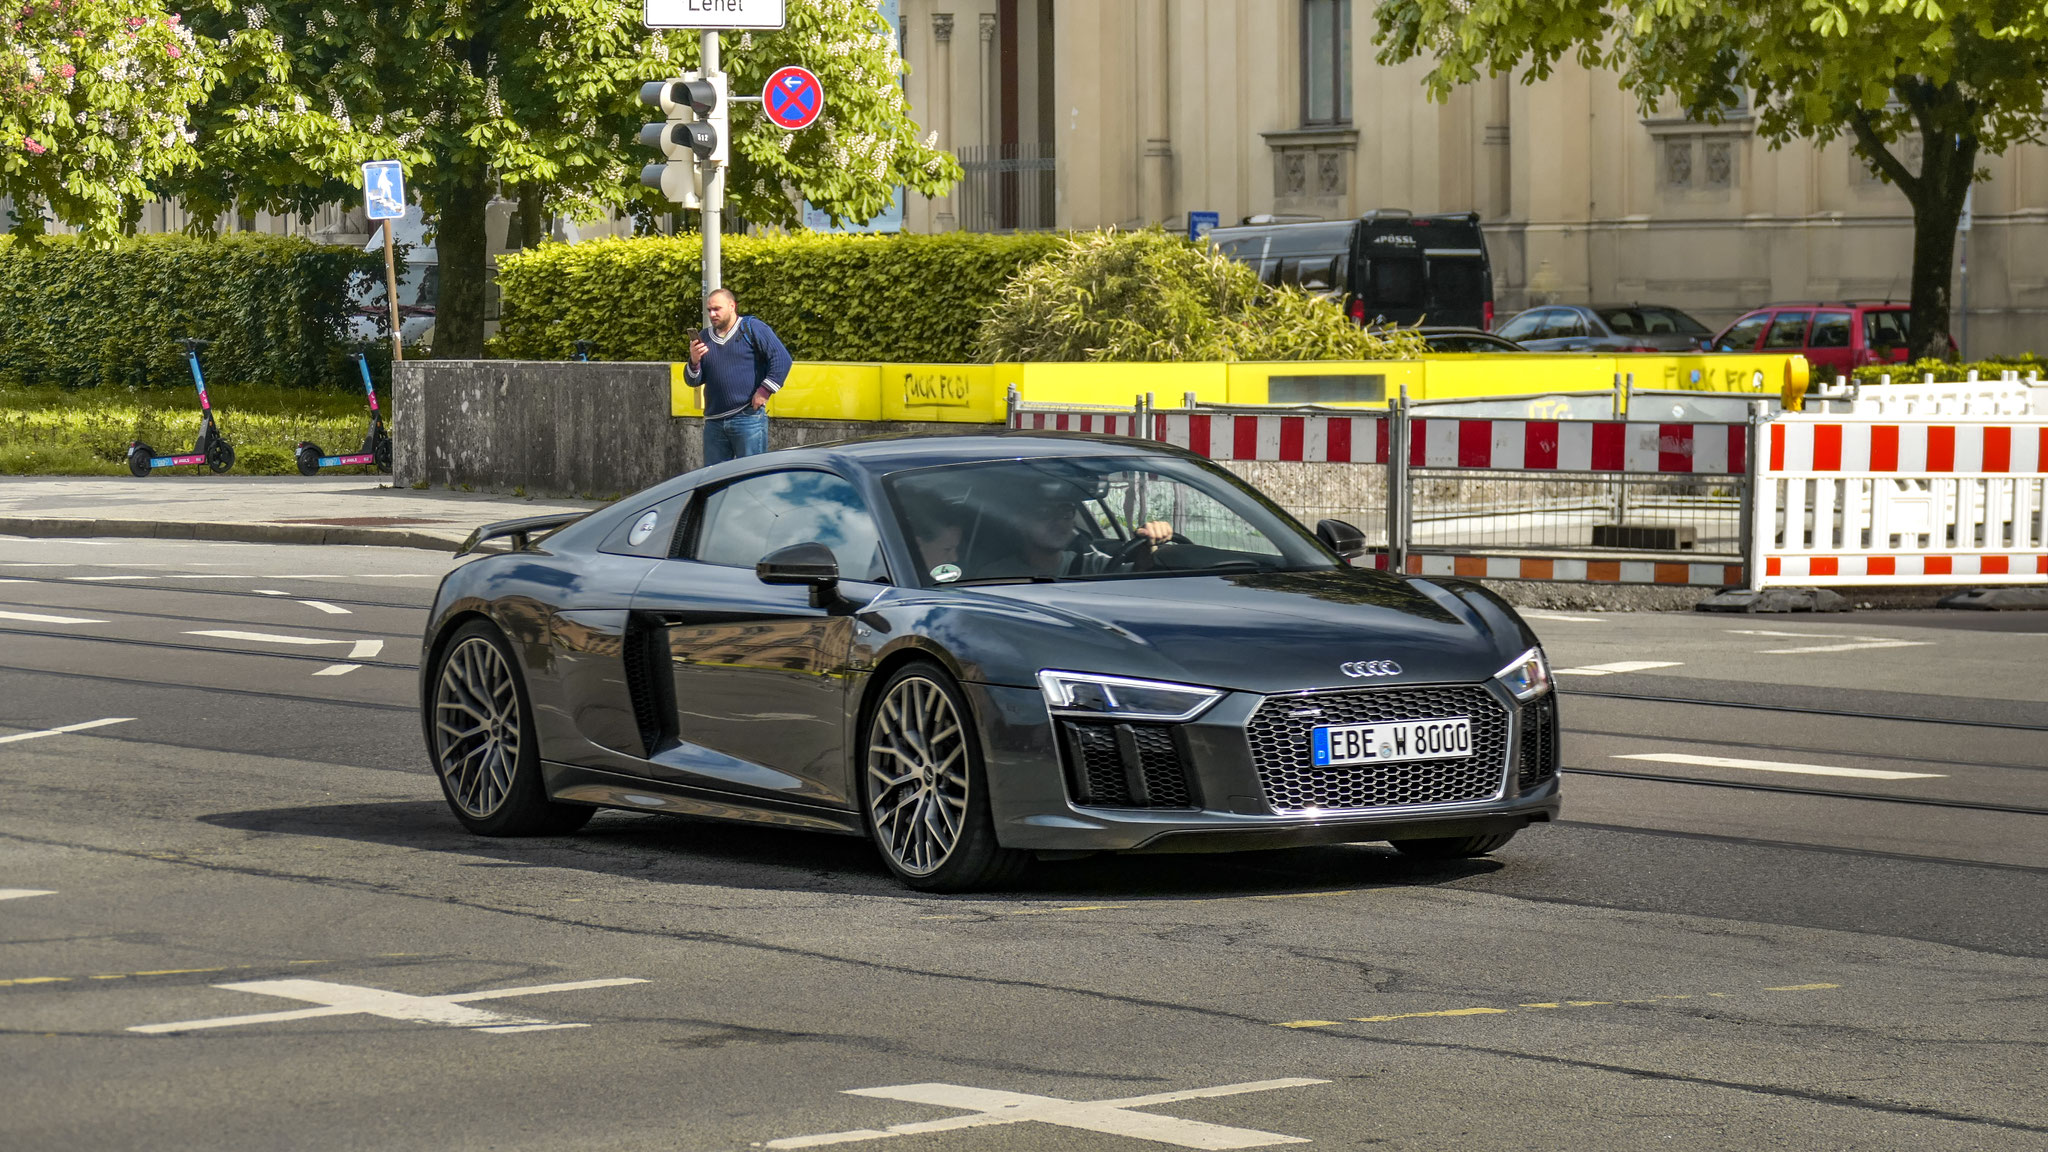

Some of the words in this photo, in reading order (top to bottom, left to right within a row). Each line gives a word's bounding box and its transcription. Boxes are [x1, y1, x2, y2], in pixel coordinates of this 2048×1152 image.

[1330, 729, 1377, 760] EBE
[1393, 727, 1407, 755] W
[1415, 723, 1468, 754] 8000
